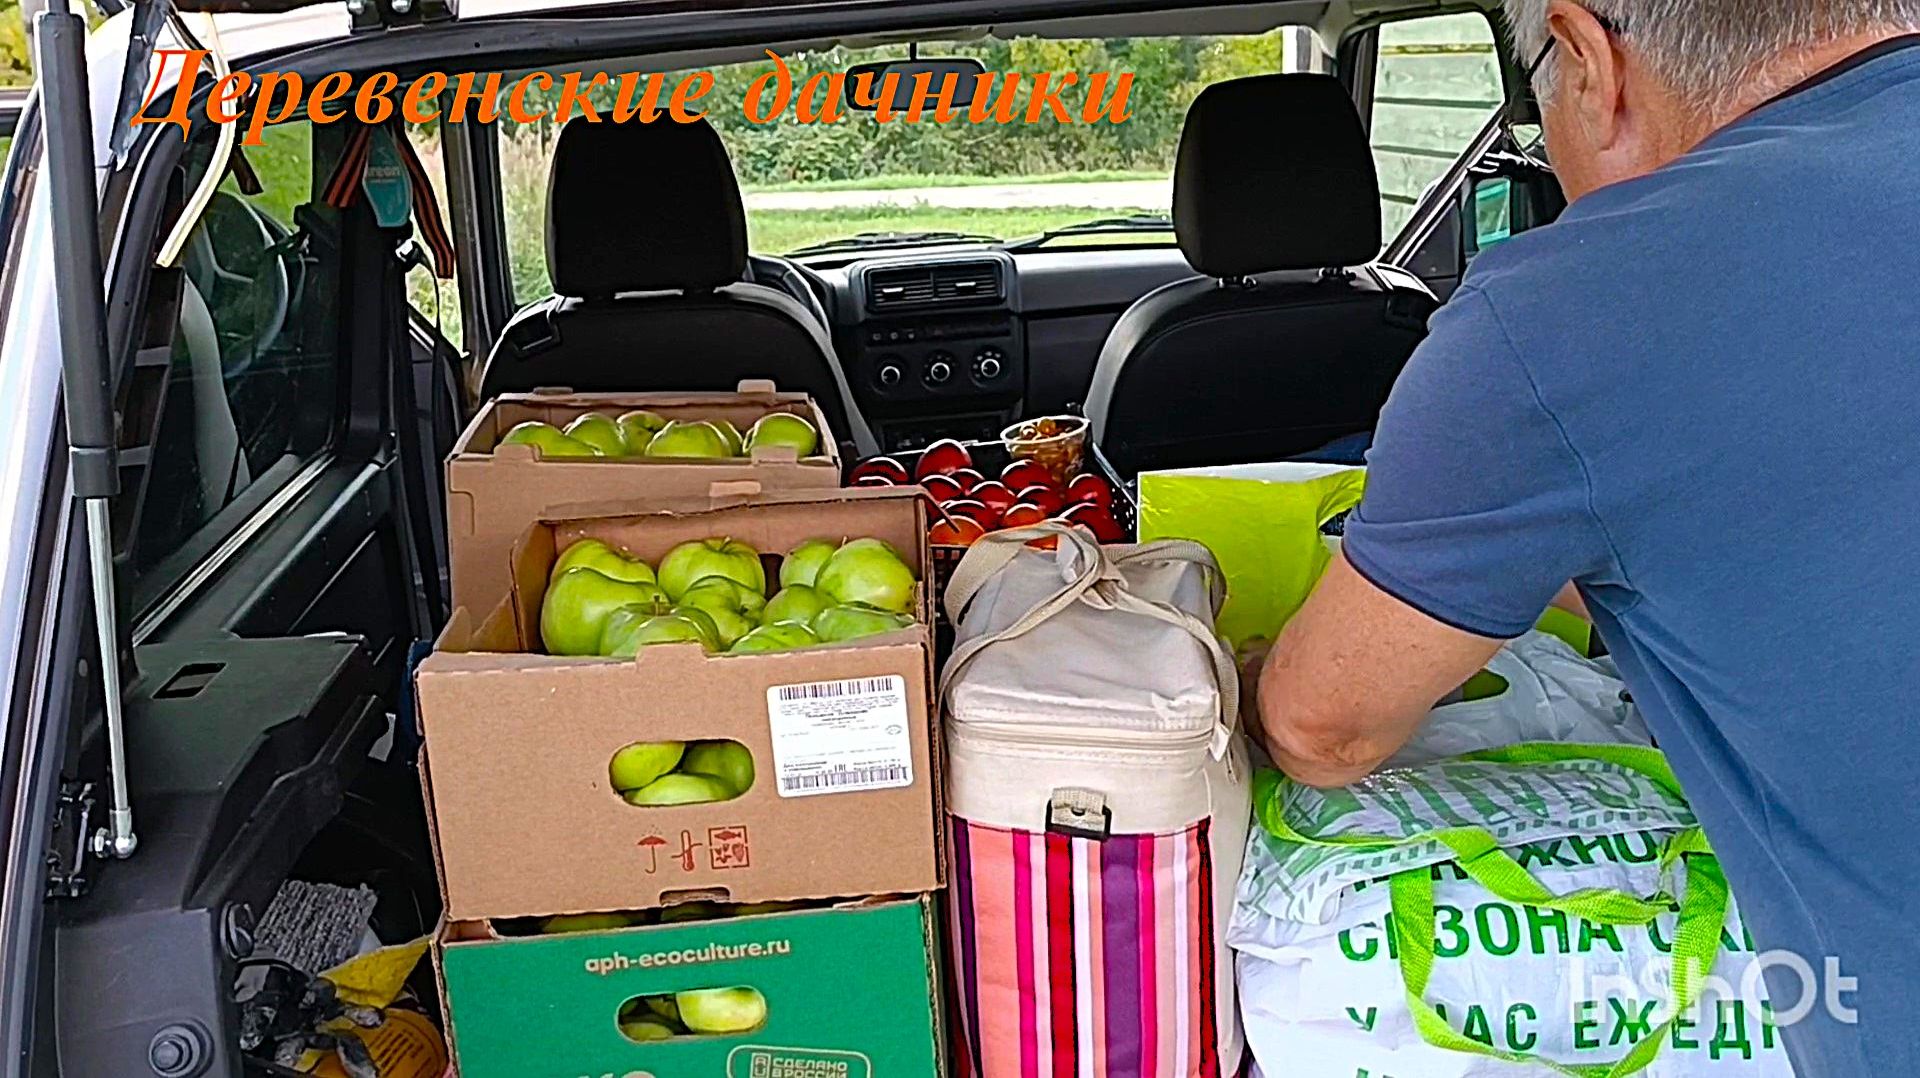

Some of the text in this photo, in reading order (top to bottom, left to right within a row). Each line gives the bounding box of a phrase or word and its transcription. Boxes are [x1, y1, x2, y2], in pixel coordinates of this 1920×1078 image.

[1337, 902, 1624, 962] СЗОНА
[585, 937, 791, 975] aph-ecoculture.ru
[772, 1057, 848, 1072] СДЕЛАНО
